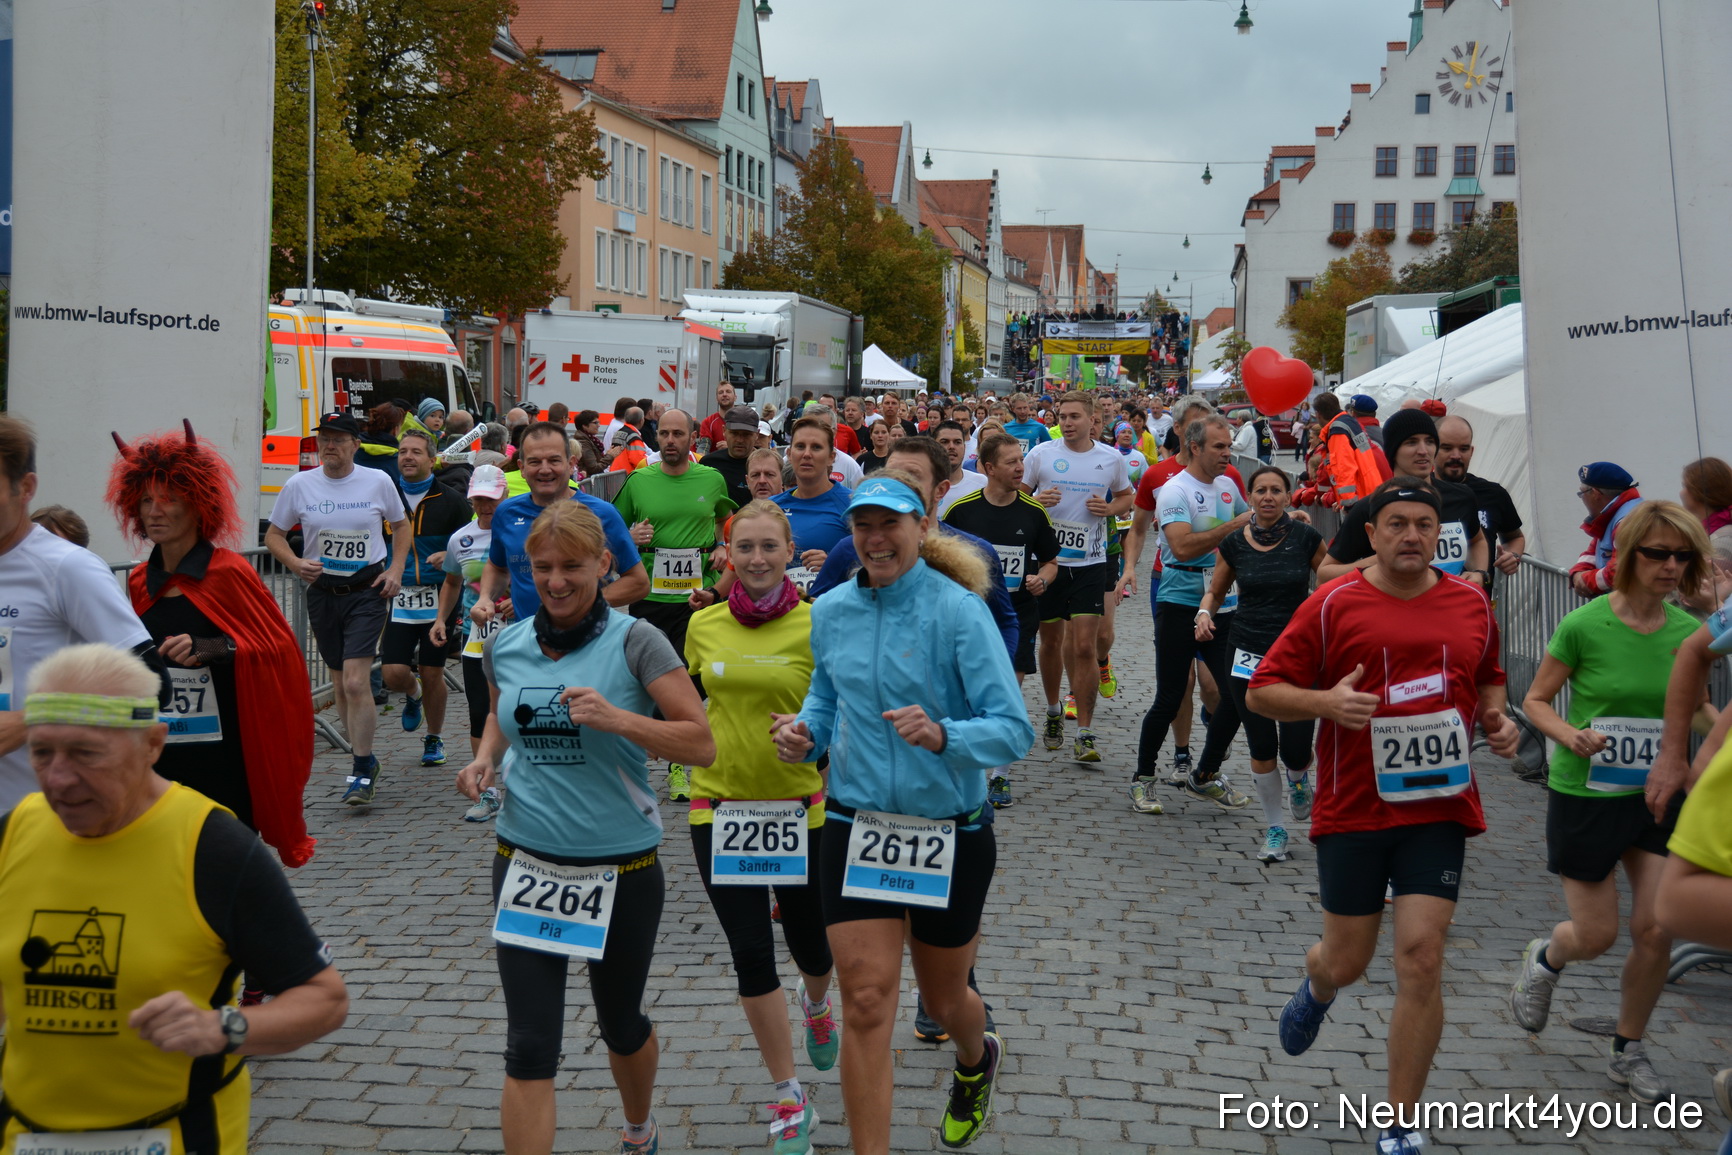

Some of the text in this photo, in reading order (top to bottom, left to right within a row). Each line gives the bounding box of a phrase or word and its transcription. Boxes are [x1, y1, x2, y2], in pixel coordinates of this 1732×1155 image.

[15, 302, 220, 332] www.bmw-laufsport.de
[1567, 307, 1732, 339] www.bmw-lauf
[1077, 343, 1114, 352] START
[594, 355, 645, 365] Bayerisches
[594, 366, 618, 374] Rotes
[348, 378, 373, 393] Bayerisches
[593, 376, 617, 384] Kreuz
[865, 378, 898, 387] Laufsport
[337, 501, 371, 510] NEUMARKT
[1061, 523, 1083, 531] Neumarkt
[1055, 529, 1085, 548] 036
[323, 540, 366, 559] 2789
[1436, 537, 1462, 560] 05
[328, 560, 359, 570] Christian
[663, 560, 693, 577] 144
[398, 592, 434, 608] 3115
[1404, 682, 1428, 695] DEHN
[169, 721, 189, 732] ABi
[1373, 720, 1450, 734] PARTL Neumarkt
[521, 737, 582, 749] HIRSCH
[1382, 731, 1461, 769] 2494
[716, 809, 791, 817] PARTL Neumarkt
[888, 822, 937, 831] Neumarkt
[723, 821, 799, 852] 2265
[859, 830, 944, 869] 2612
[513, 858, 599, 881] PARTL Neumarkt
[739, 860, 781, 872] Sandra
[880, 873, 915, 890] Petra
[512, 873, 604, 920] 2264
[539, 921, 562, 938] Pia
[25, 987, 118, 1010] HIRSCH
[26, 1017, 118, 1028] APOTHEKE
